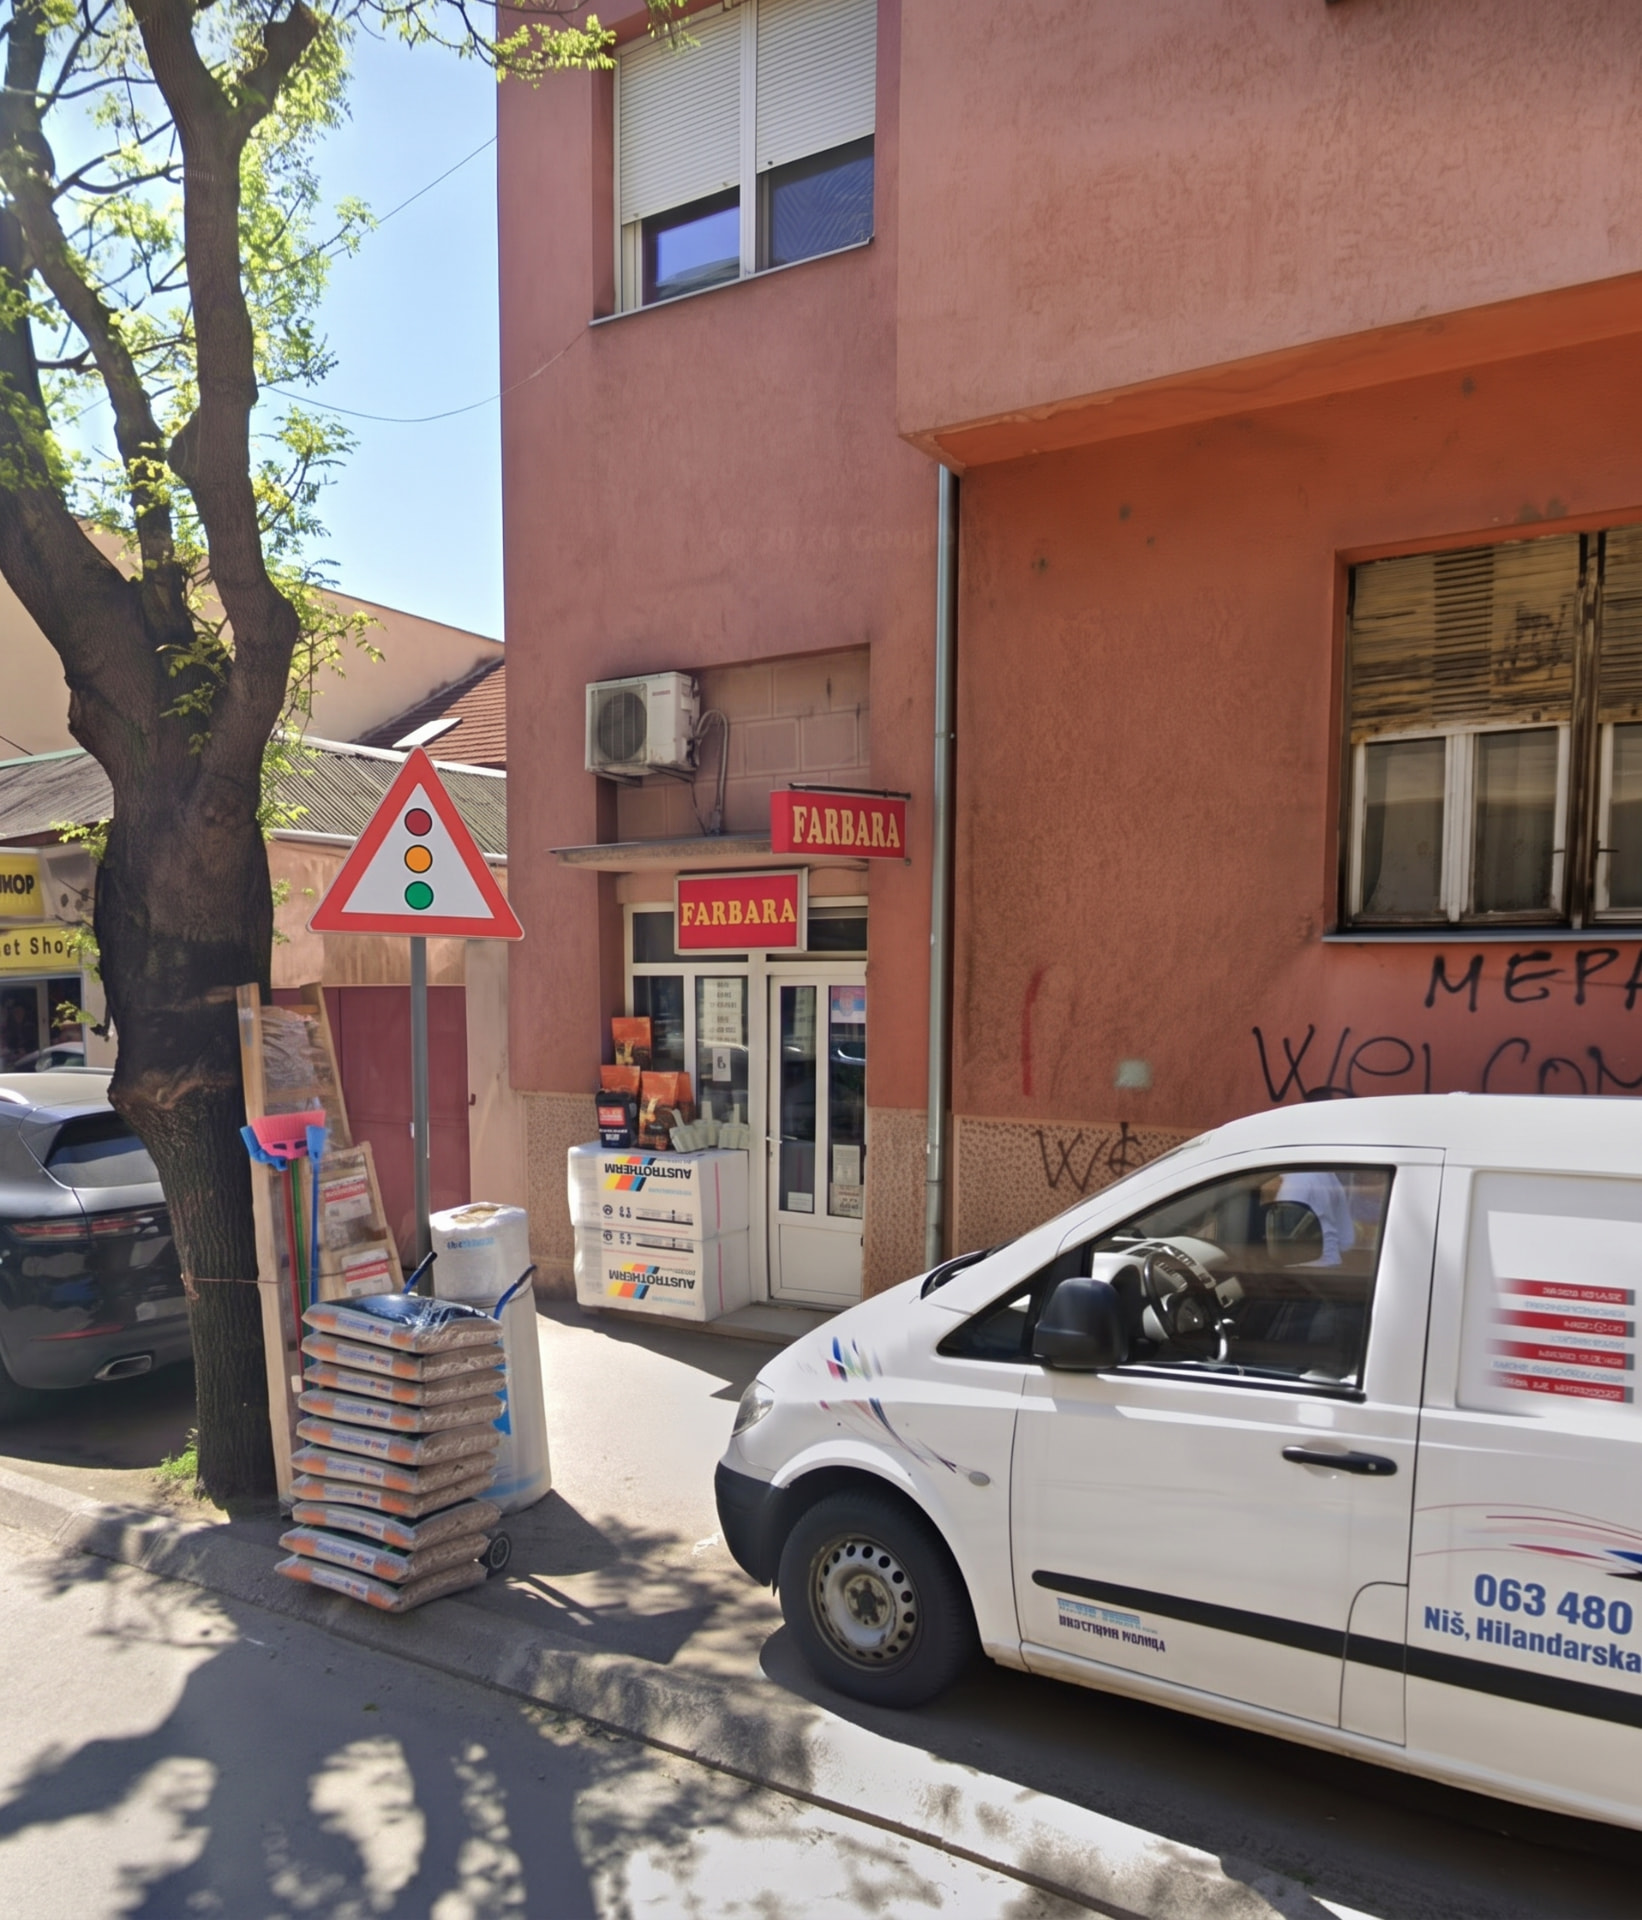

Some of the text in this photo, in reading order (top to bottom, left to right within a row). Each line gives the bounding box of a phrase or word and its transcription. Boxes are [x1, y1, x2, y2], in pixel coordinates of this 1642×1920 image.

[792, 805, 900, 848] FARBARA
[681, 898, 797, 927] FARBARA
[605, 1163, 692, 1179] AUSTROTHERM
[609, 1269, 695, 1290] AUSTROTHERM
[1474, 1573, 1633, 1635] 063 480
[1424, 1605, 1642, 1674] Niš, Hilandarska
